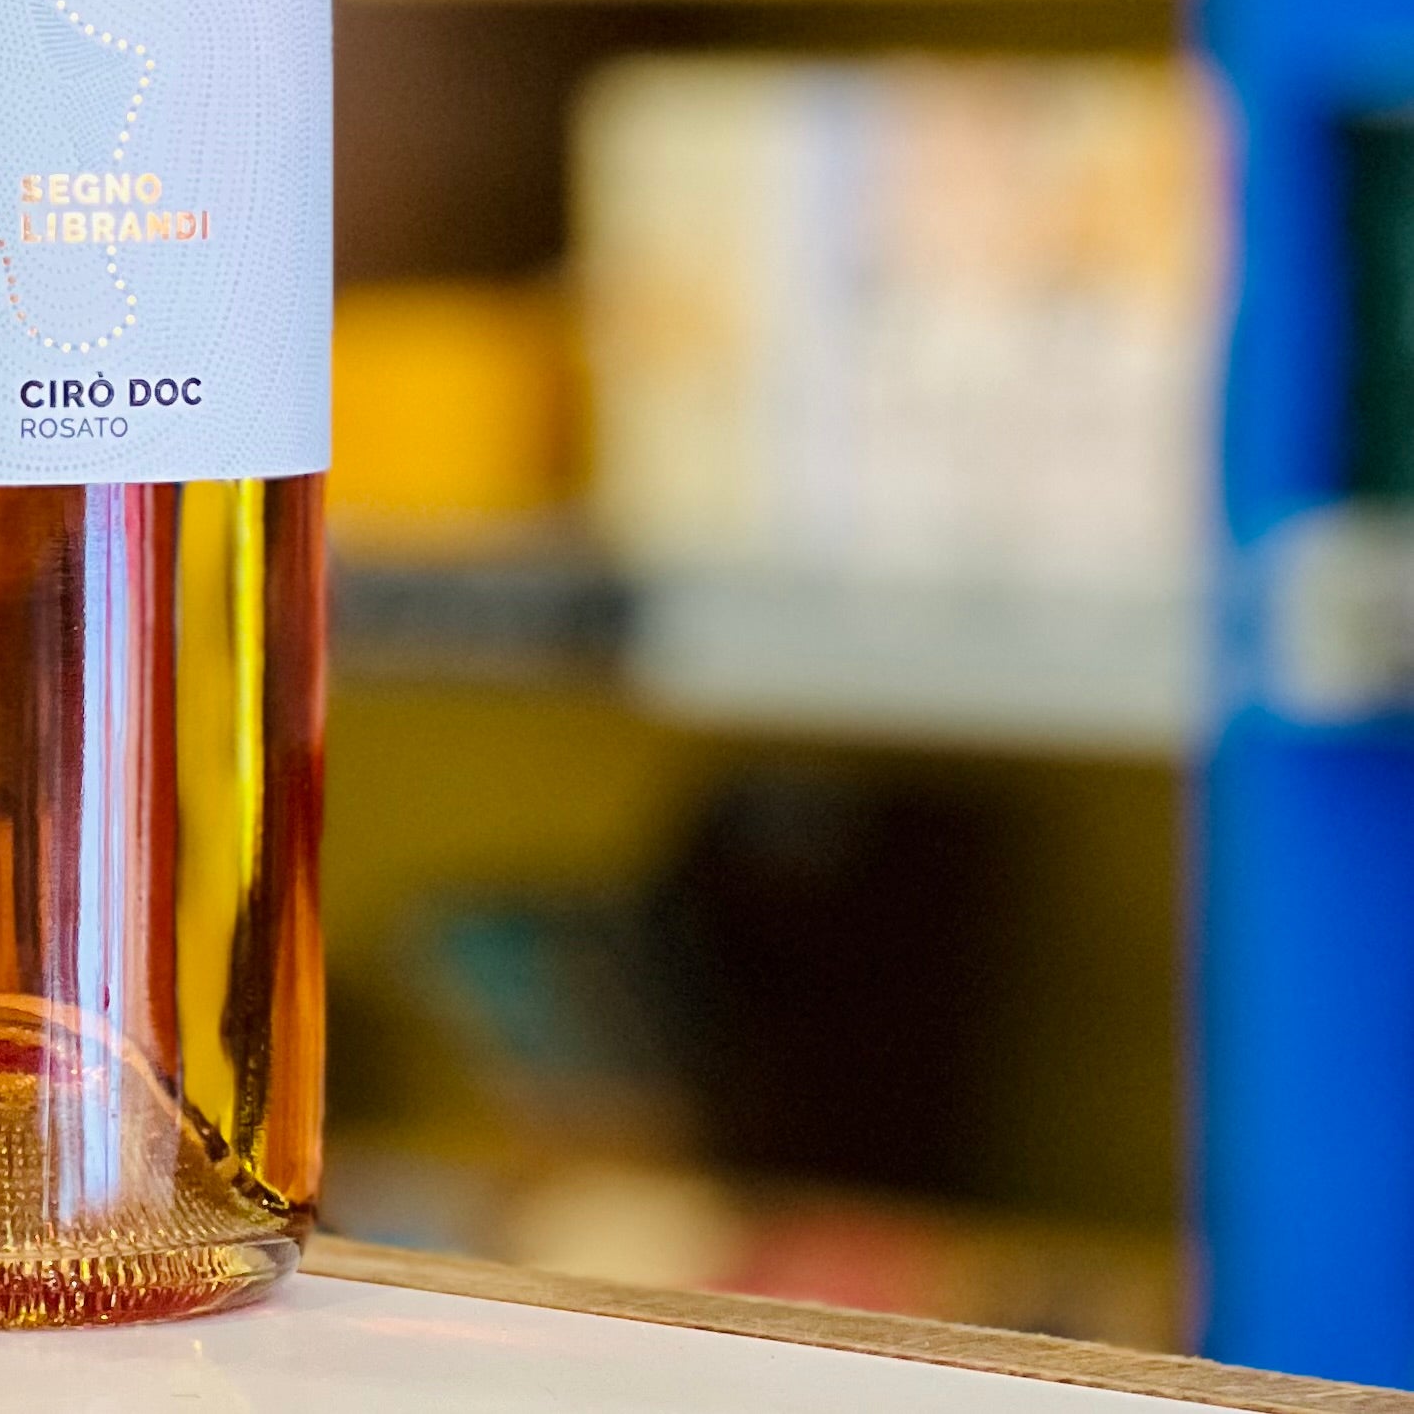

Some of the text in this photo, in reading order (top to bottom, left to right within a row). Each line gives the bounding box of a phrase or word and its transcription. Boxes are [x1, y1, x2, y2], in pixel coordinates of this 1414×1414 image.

[21, 174, 162, 204] SEGNO
[21, 211, 209, 243] LIBRANDI
[20, 371, 203, 409] CIRÒ DOC
[20, 416, 129, 439] ROSATO
